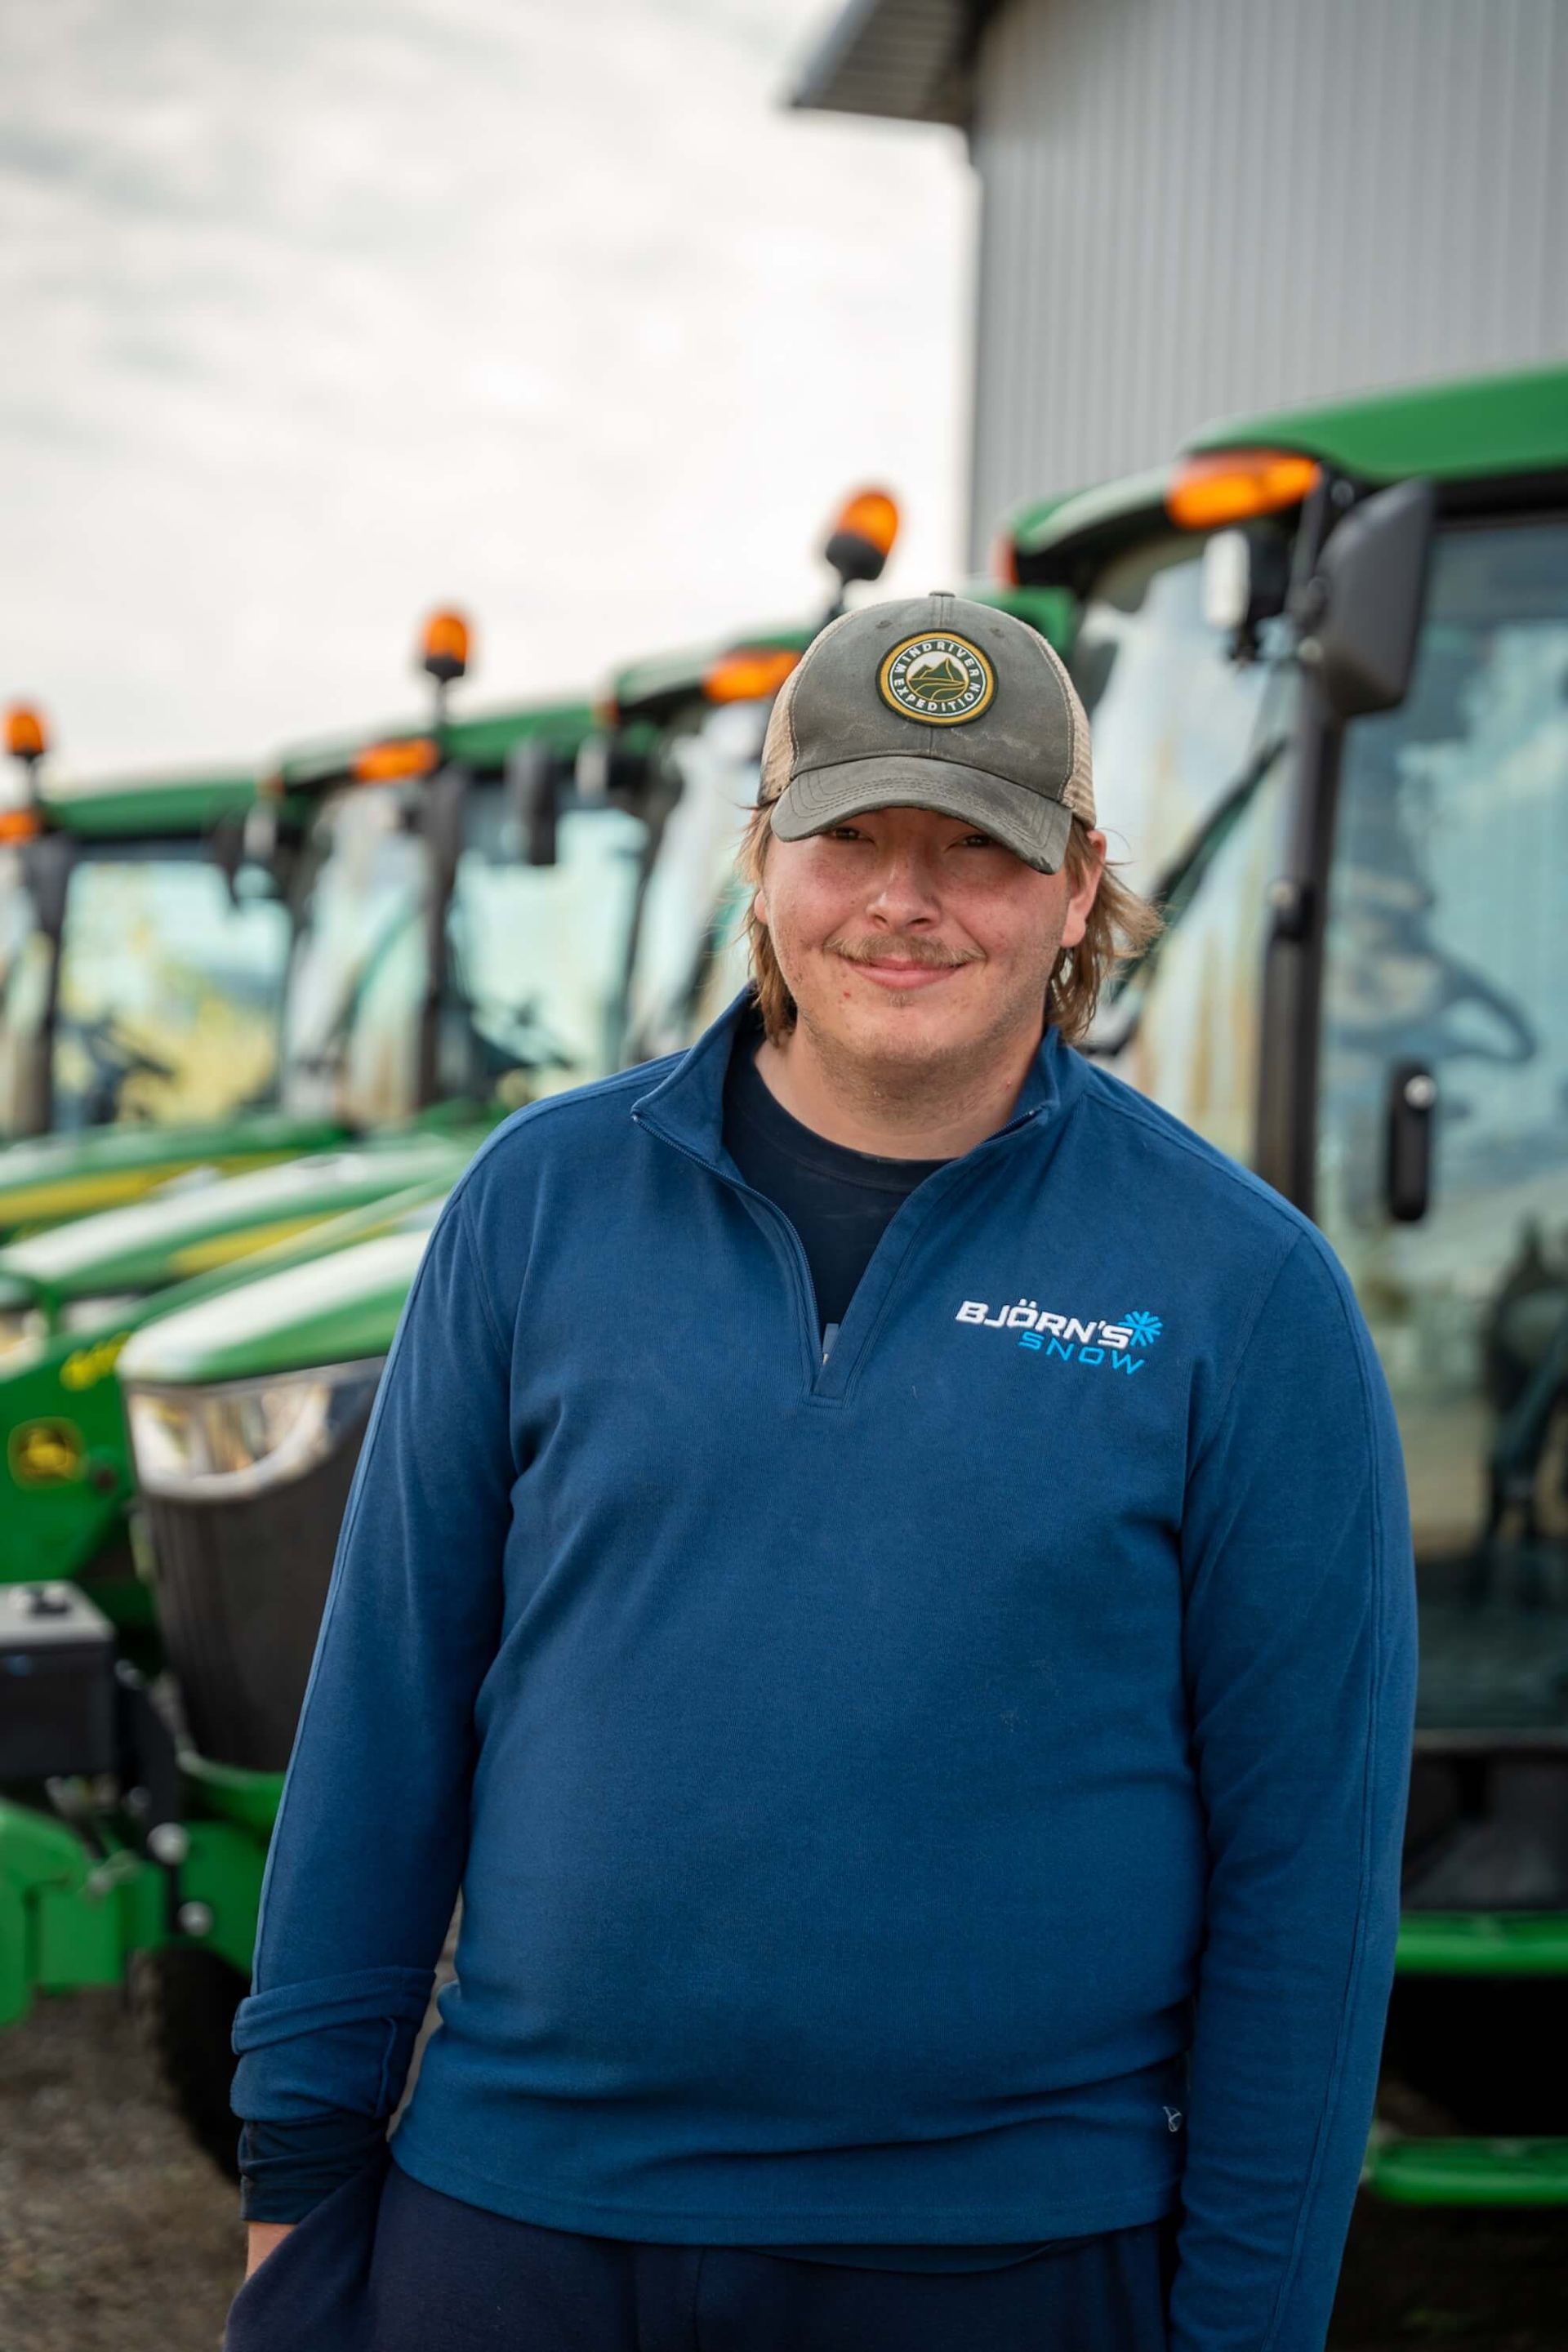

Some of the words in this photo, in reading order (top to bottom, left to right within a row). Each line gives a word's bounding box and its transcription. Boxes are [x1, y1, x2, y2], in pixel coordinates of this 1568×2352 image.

[894, 641, 979, 676] WINDRIVER
[894, 678, 980, 711] EXPEDITION
[956, 1298, 1134, 1349] BJÖRN'S
[1018, 1331, 1143, 1374] SNOW
